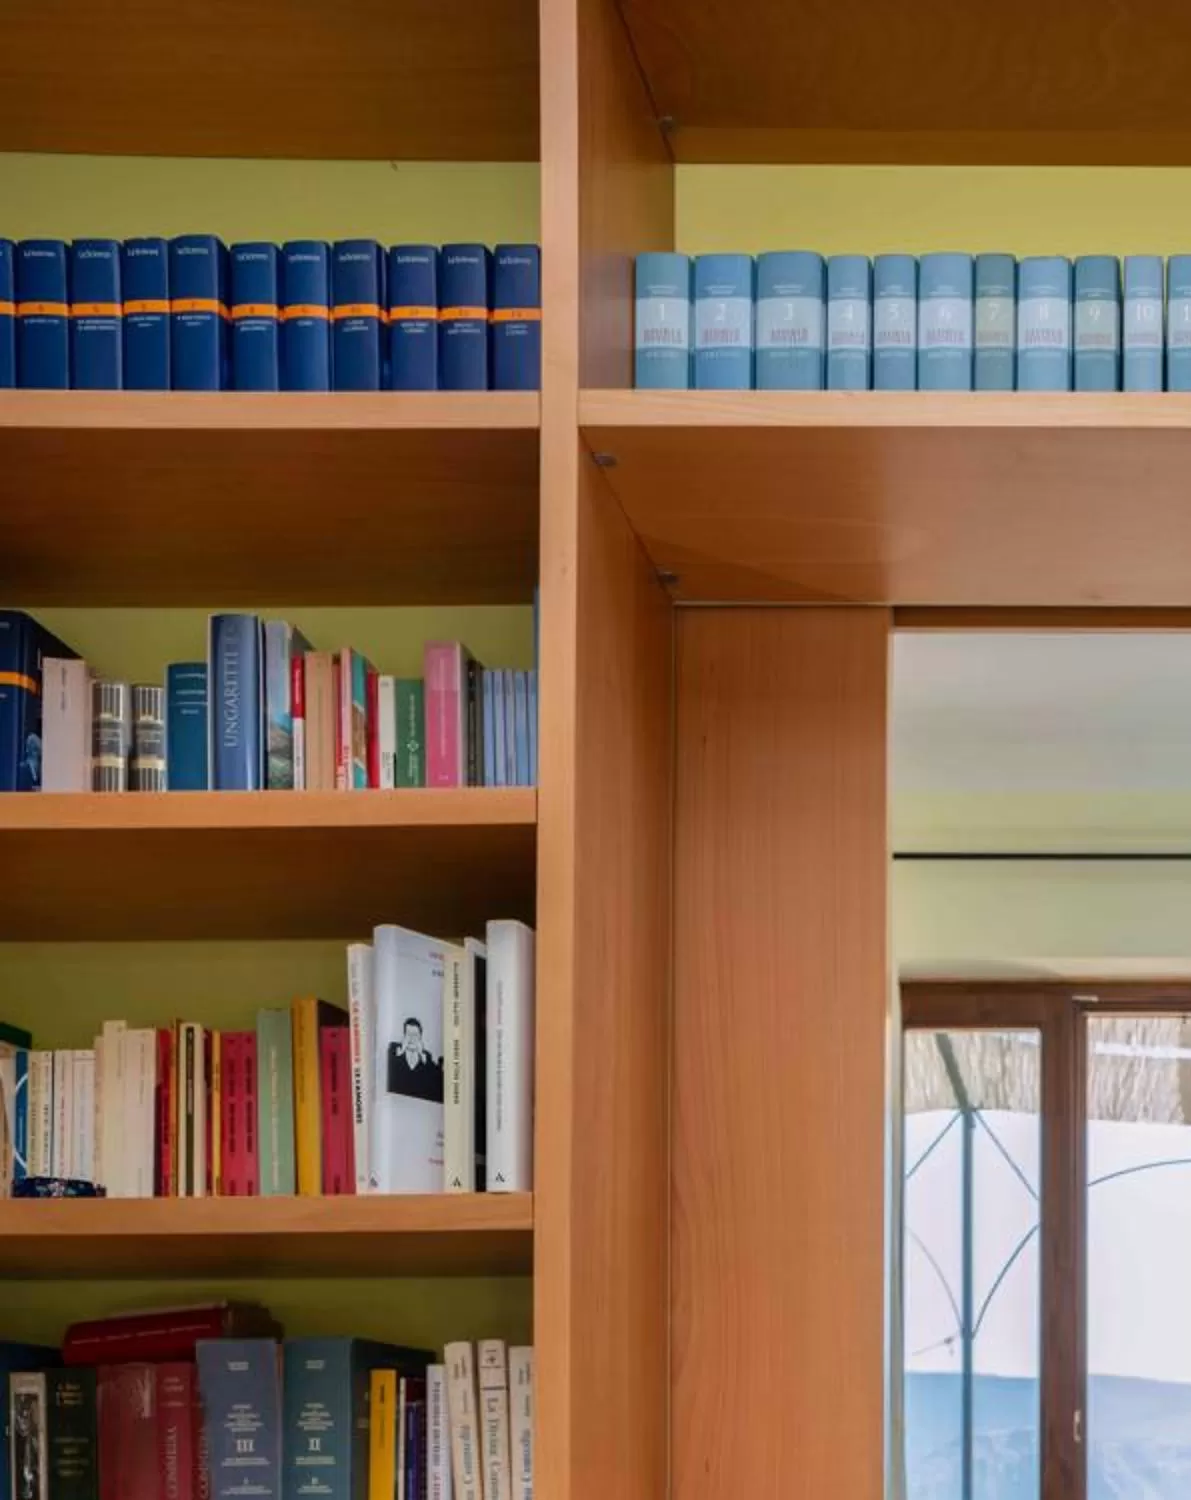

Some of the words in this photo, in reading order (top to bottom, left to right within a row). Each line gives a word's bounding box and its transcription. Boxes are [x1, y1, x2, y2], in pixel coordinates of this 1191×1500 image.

[657, 303, 666, 321] 1
[714, 303, 726, 321] 2
[988, 303, 999, 321] 7
[1135, 304, 1155, 321] 10
[223, 651, 239, 748] UNGARETTI
